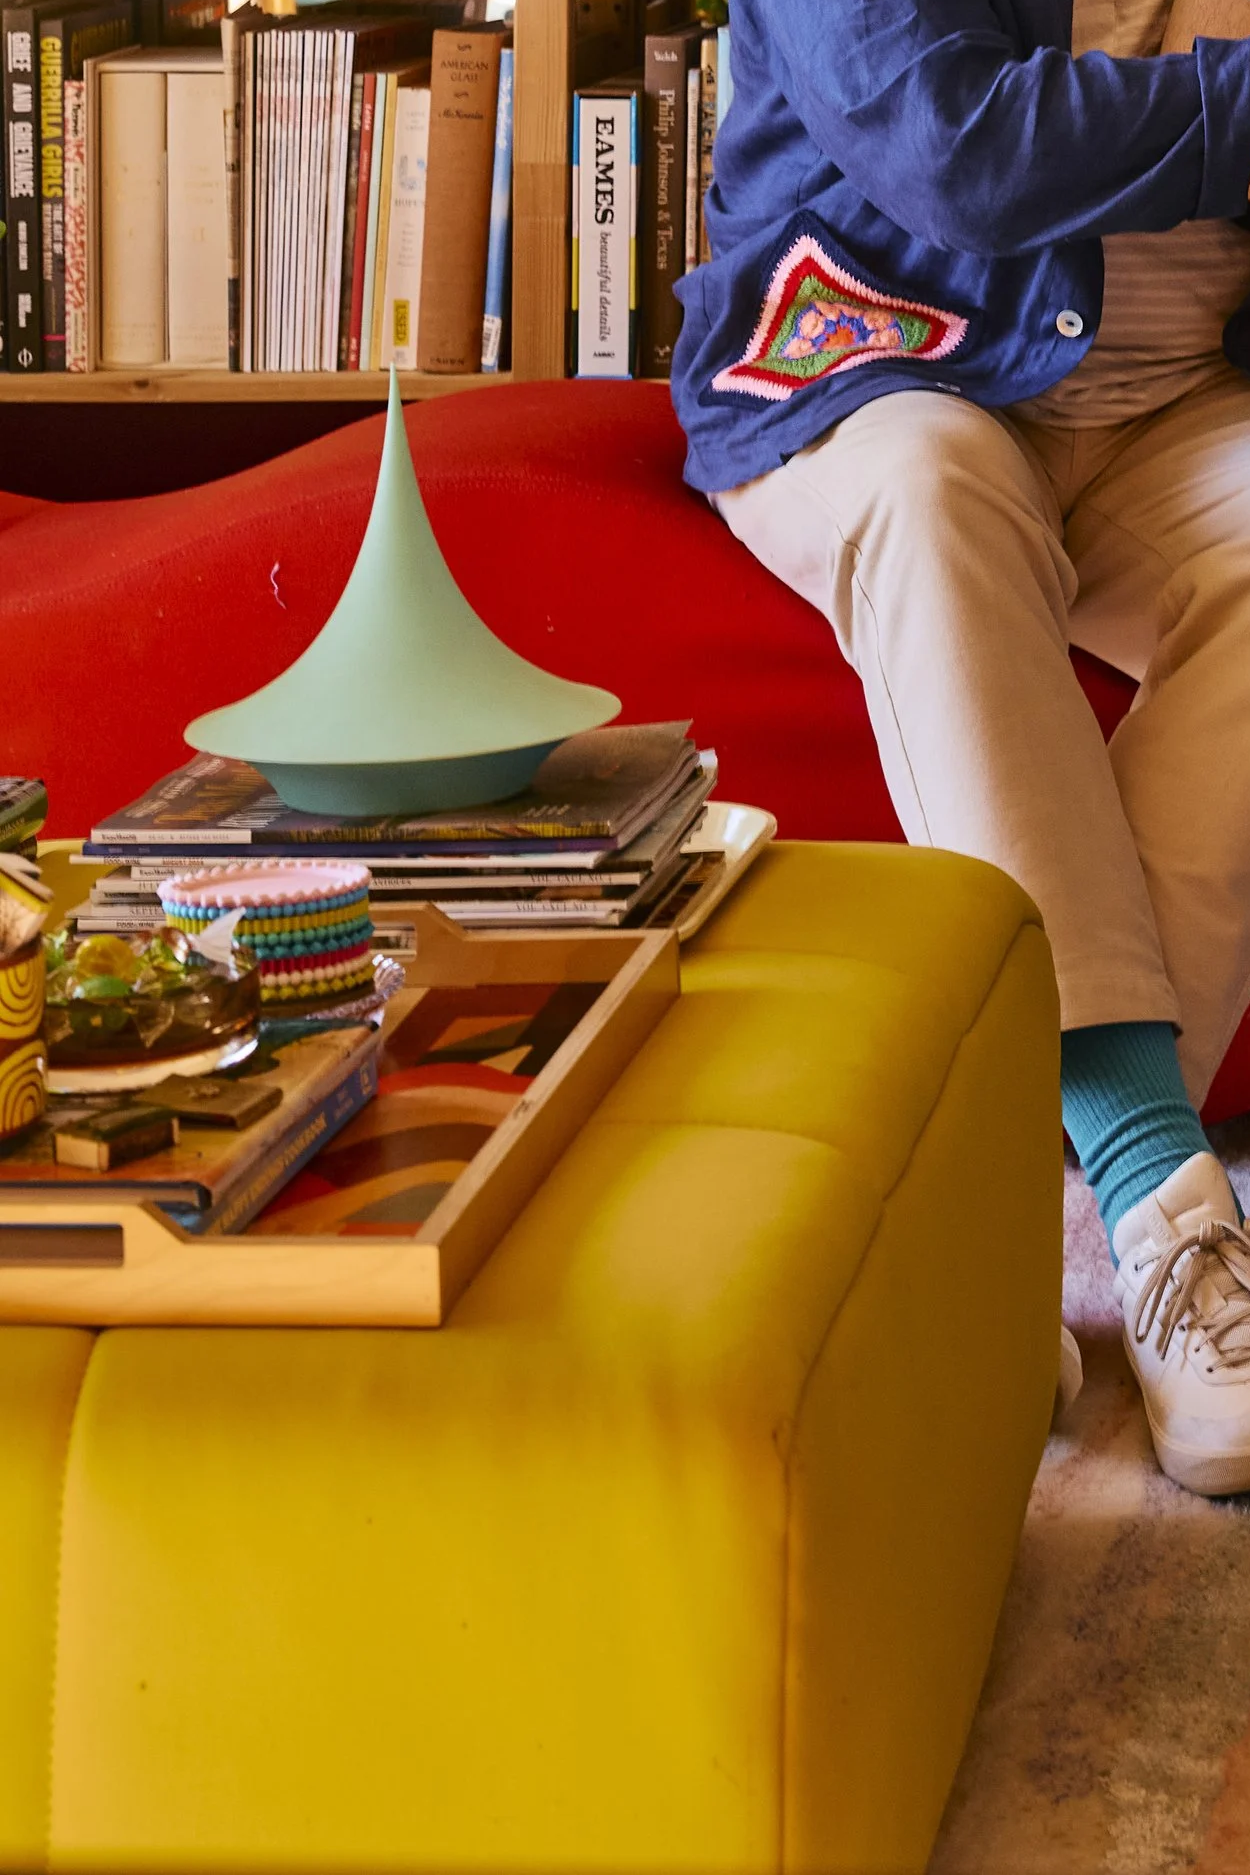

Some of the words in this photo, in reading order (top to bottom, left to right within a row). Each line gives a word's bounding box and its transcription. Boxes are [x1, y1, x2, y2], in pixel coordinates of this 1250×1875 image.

[12, 32, 32, 72] GRIEF
[440, 60, 488, 72] AMERICAN
[12, 82, 32, 113] AND
[40, 36, 64, 139] GUERRILLA
[652, 88, 676, 136] Philip
[13, 120, 34, 198] GRIEVANCE
[40, 144, 64, 198] GIRLS
[594, 116, 616, 225] EAMES
[654, 140, 676, 206] Johnson
[658, 210, 673, 222] &
[596, 232, 614, 294] beautiful
[656, 227, 675, 270] Texas
[598, 296, 614, 342] details
